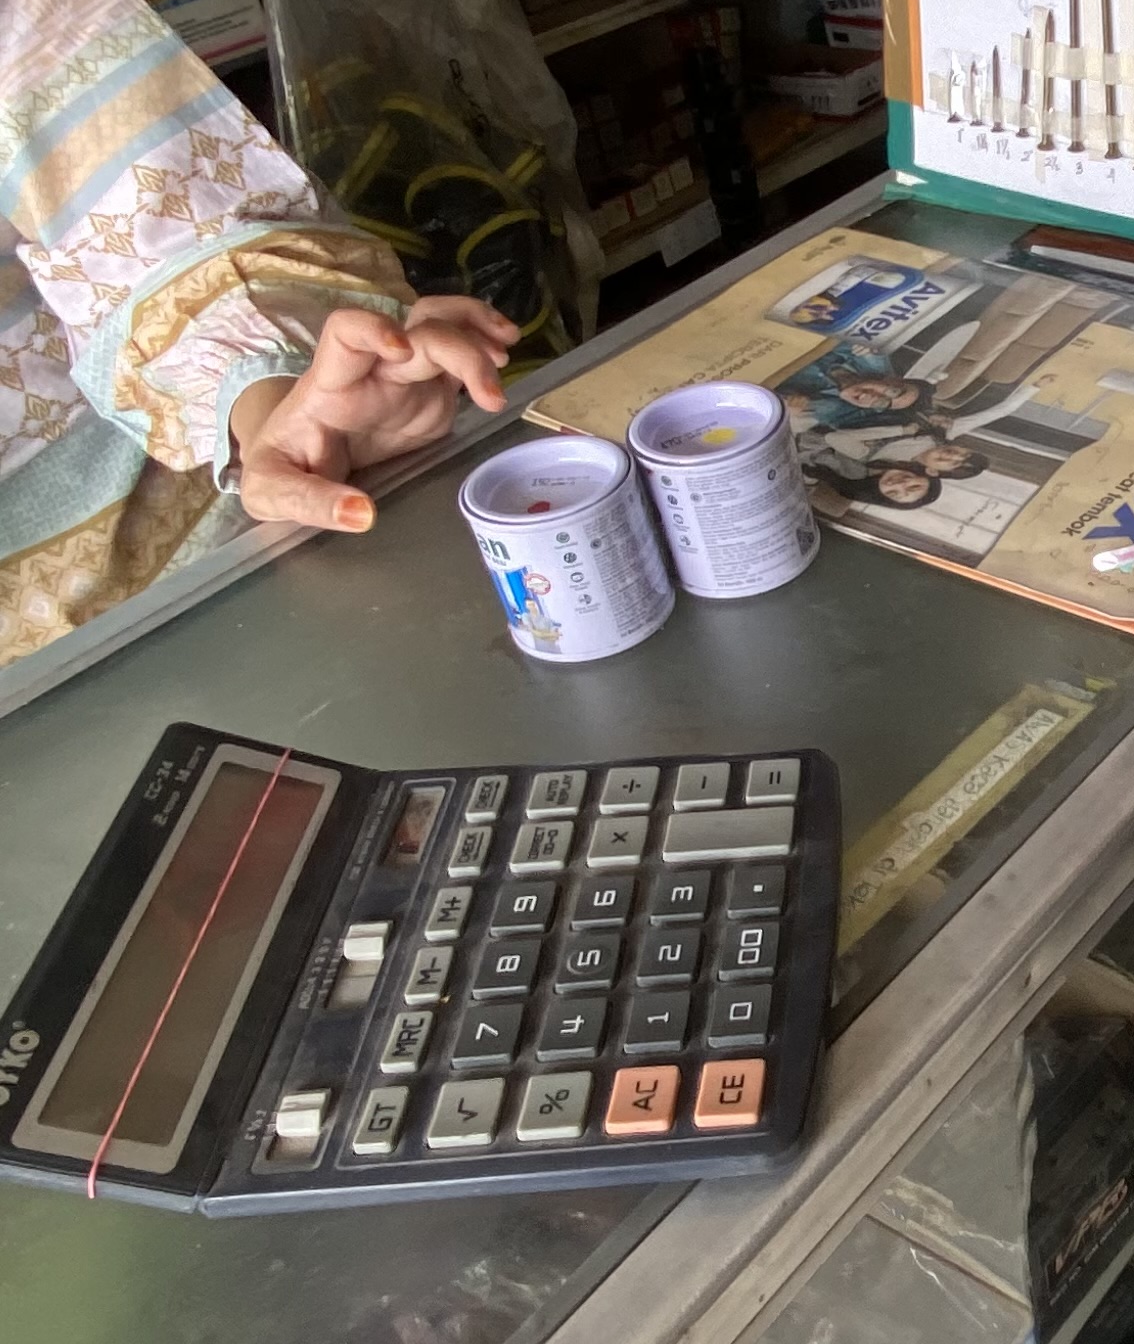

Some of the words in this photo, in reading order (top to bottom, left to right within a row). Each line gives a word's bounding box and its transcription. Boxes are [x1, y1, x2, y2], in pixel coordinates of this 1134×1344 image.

[1075, 162, 1085, 175] 3
[855, 279, 948, 344] Avitex
[1061, 489, 1124, 538] tembok
[512, 895, 538, 913] 9
[593, 889, 617, 906] 6
[671, 885, 694, 903] 3
[437, 896, 462, 923] M+
[658, 943, 682, 962] 2
[737, 928, 763, 965] 00
[495, 954, 521, 973] 8
[576, 949, 601, 967] 5
[415, 956, 443, 986] M-
[647, 1011, 670, 1023] 1
[729, 1001, 753, 1021] 0
[475, 1022, 499, 1040] 7
[559, 1014, 585, 1034] 4
[391, 1017, 425, 1057] MRC
[633, 1079, 659, 1112] AC
[719, 1073, 745, 1105] CE
[538, 1088, 570, 1116] %
[367, 1103, 397, 1132] GT
